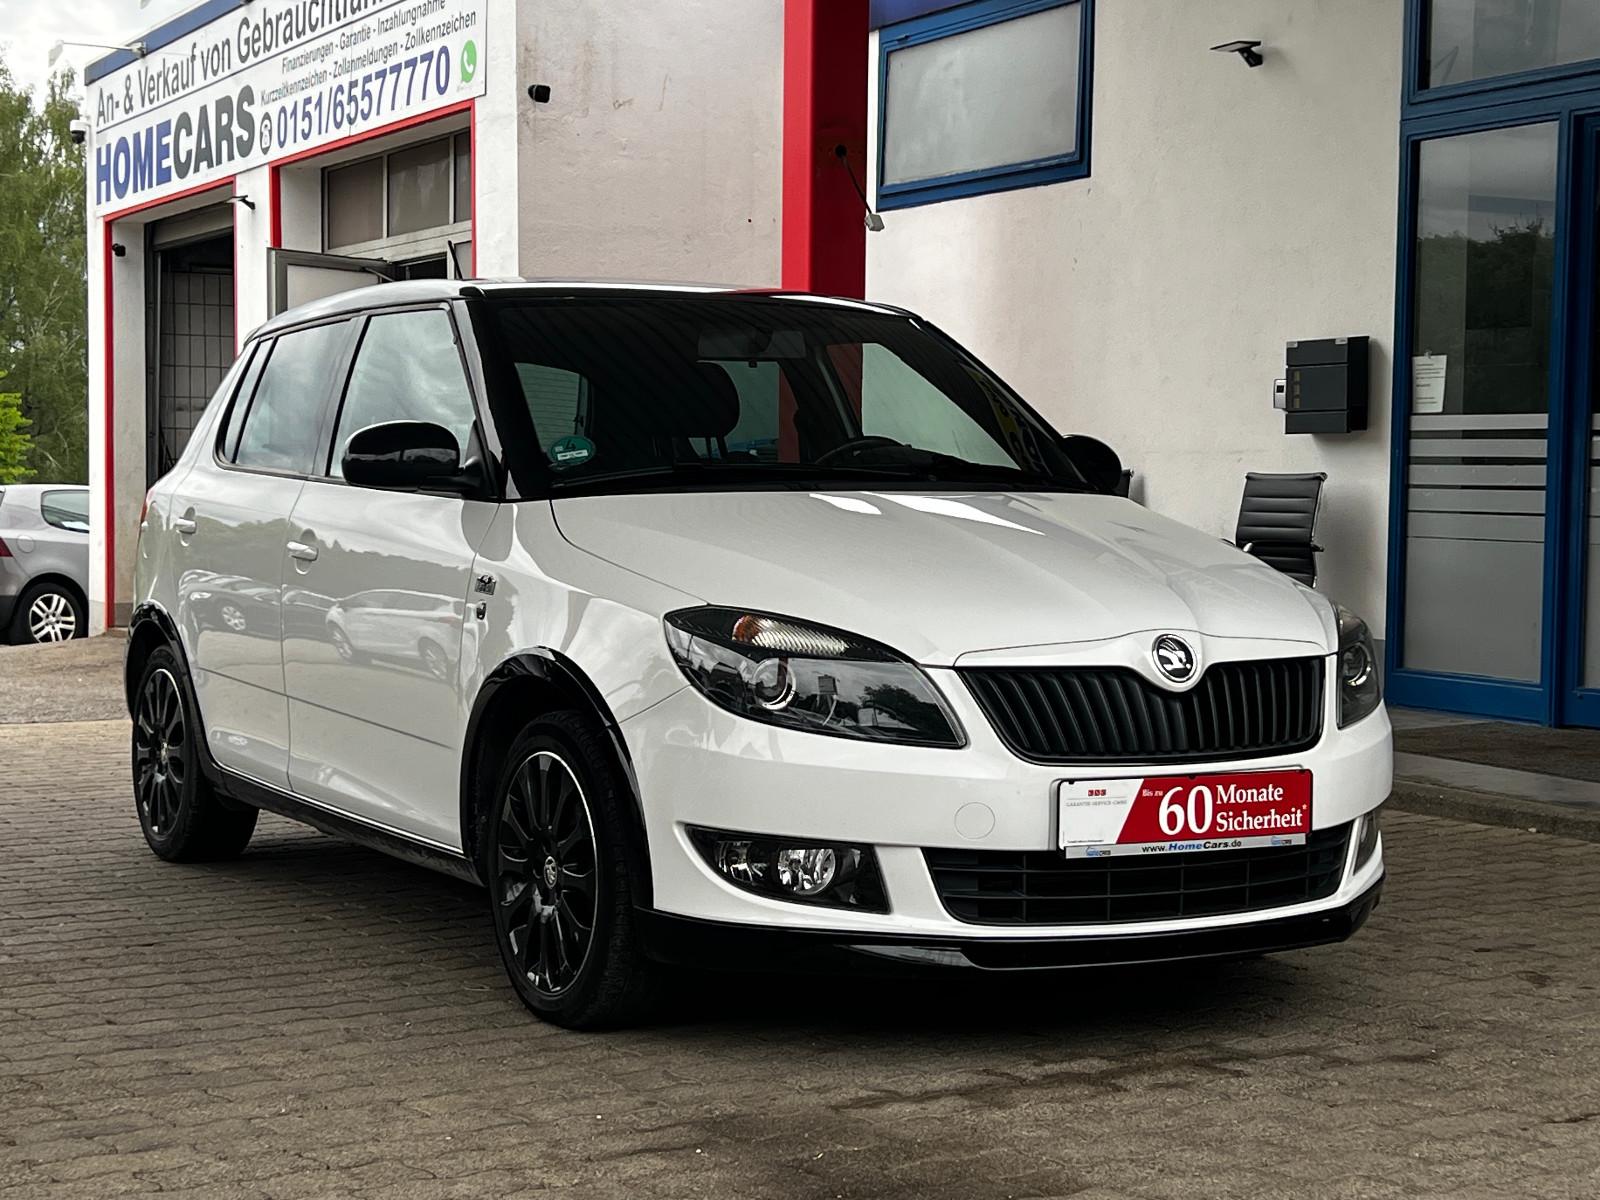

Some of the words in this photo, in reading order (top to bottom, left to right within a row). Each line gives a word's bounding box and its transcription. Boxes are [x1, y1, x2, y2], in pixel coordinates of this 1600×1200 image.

[282, 42, 334, 75] Finanzierungen
[340, 24, 371, 50] Garantie
[378, 0, 446, 36] Inzahlungnahme
[333, 43, 398, 79] Zollanmeldungen
[405, 10, 477, 52] Zollkennzeichen
[97, 87, 120, 127] An-
[124, 74, 134, 115] &
[138, 42, 197, 108] Verkauf
[201, 38, 231, 81] von
[277, 45, 451, 149] 0151/65577770
[1158, 786, 1213, 836] 60
[1216, 783, 1284, 805] Monate
[1141, 839, 1242, 853] www.HomeCars.de
